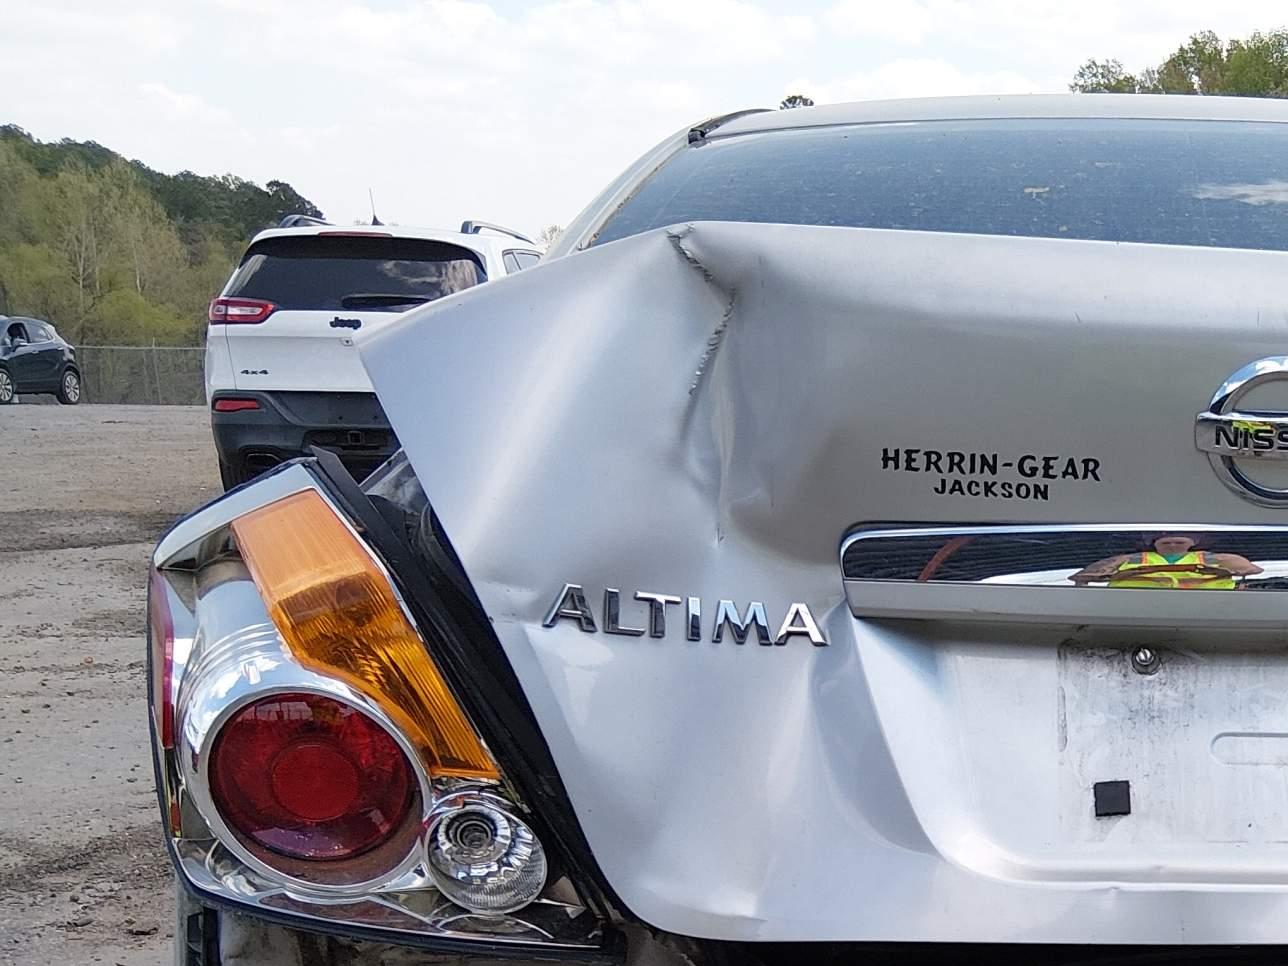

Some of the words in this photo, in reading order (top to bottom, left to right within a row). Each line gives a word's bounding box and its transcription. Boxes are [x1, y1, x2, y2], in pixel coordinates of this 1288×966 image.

[329, 316, 362, 330] Jeep
[880, 447, 1101, 482] HERRIN-GEAR
[933, 478, 1049, 501] JACKSON
[542, 583, 829, 646] ALTIMA
